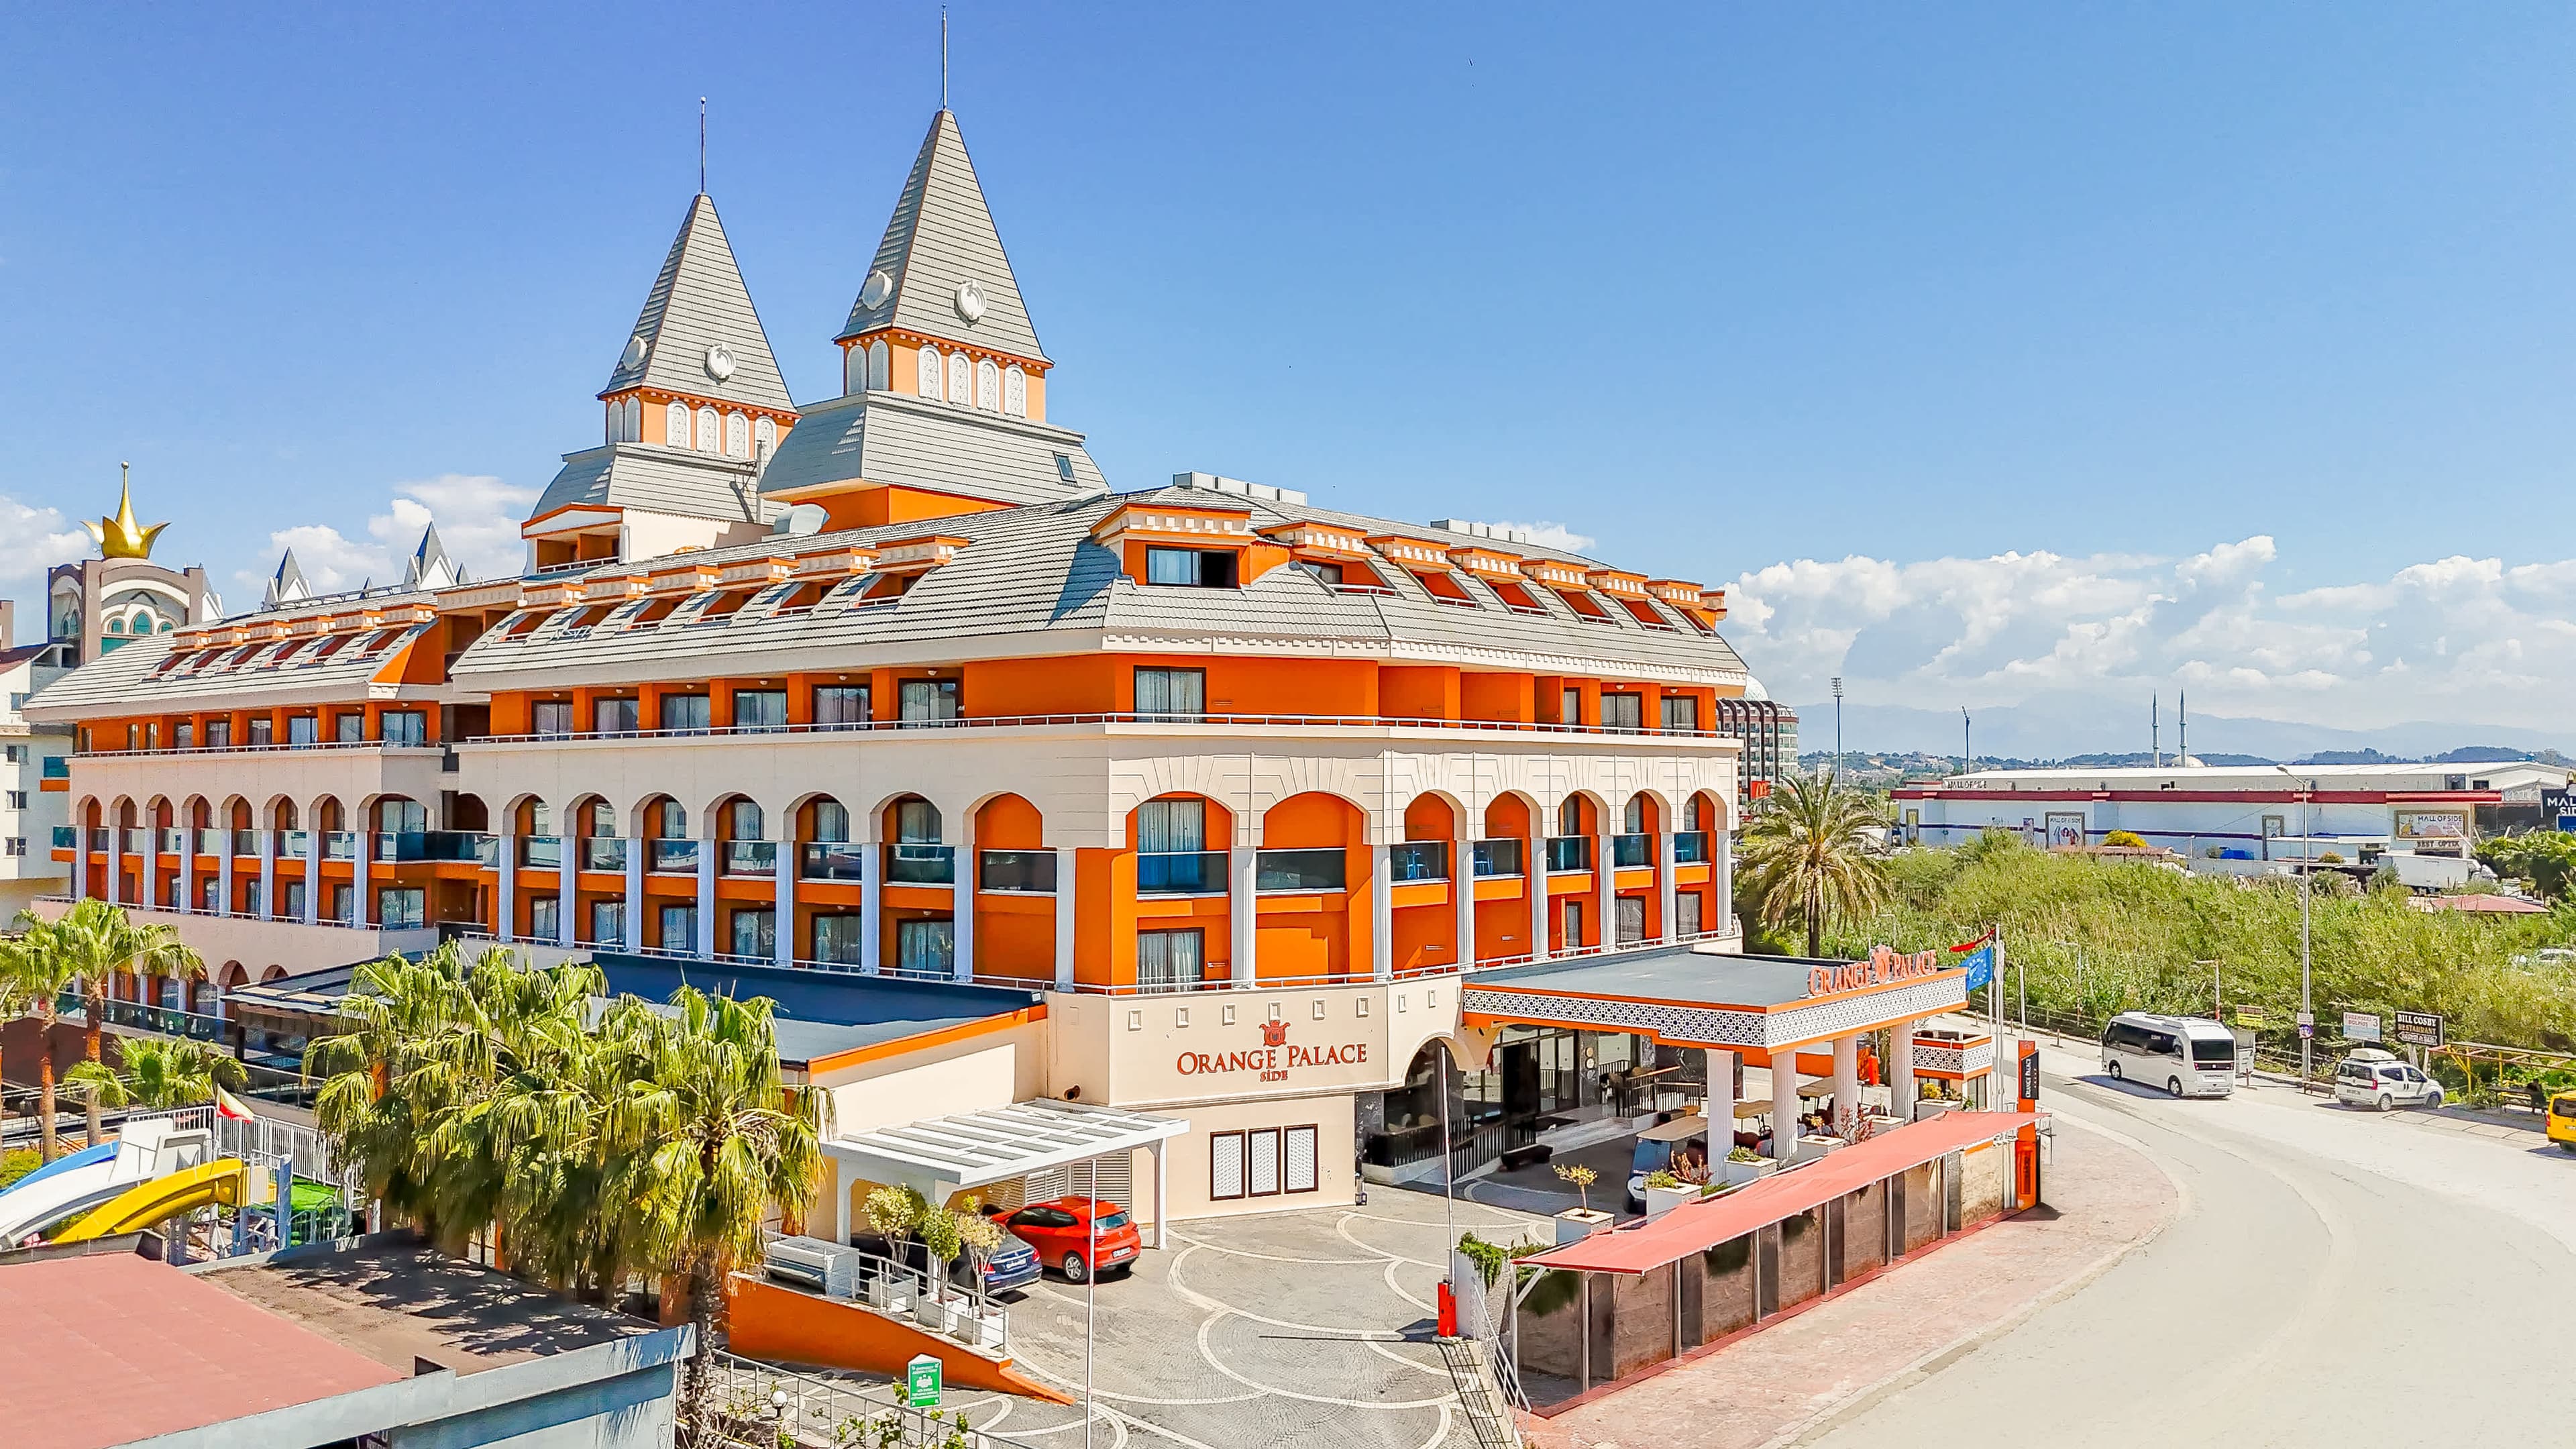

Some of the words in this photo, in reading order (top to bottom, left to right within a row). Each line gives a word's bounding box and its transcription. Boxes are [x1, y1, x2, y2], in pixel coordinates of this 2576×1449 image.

[1809, 961, 1872, 996] ORANGE
[1892, 949, 1937, 981] PALACE
[2372, 1018, 2379, 1027] 3
[2397, 1014, 2412, 1024] BILL
[2413, 1016, 2436, 1027] COSBY
[2398, 1024, 2436, 1035] RESTAURANT
[1177, 1049, 1277, 1076] ORANGE
[1286, 1043, 1368, 1068] PALACE
